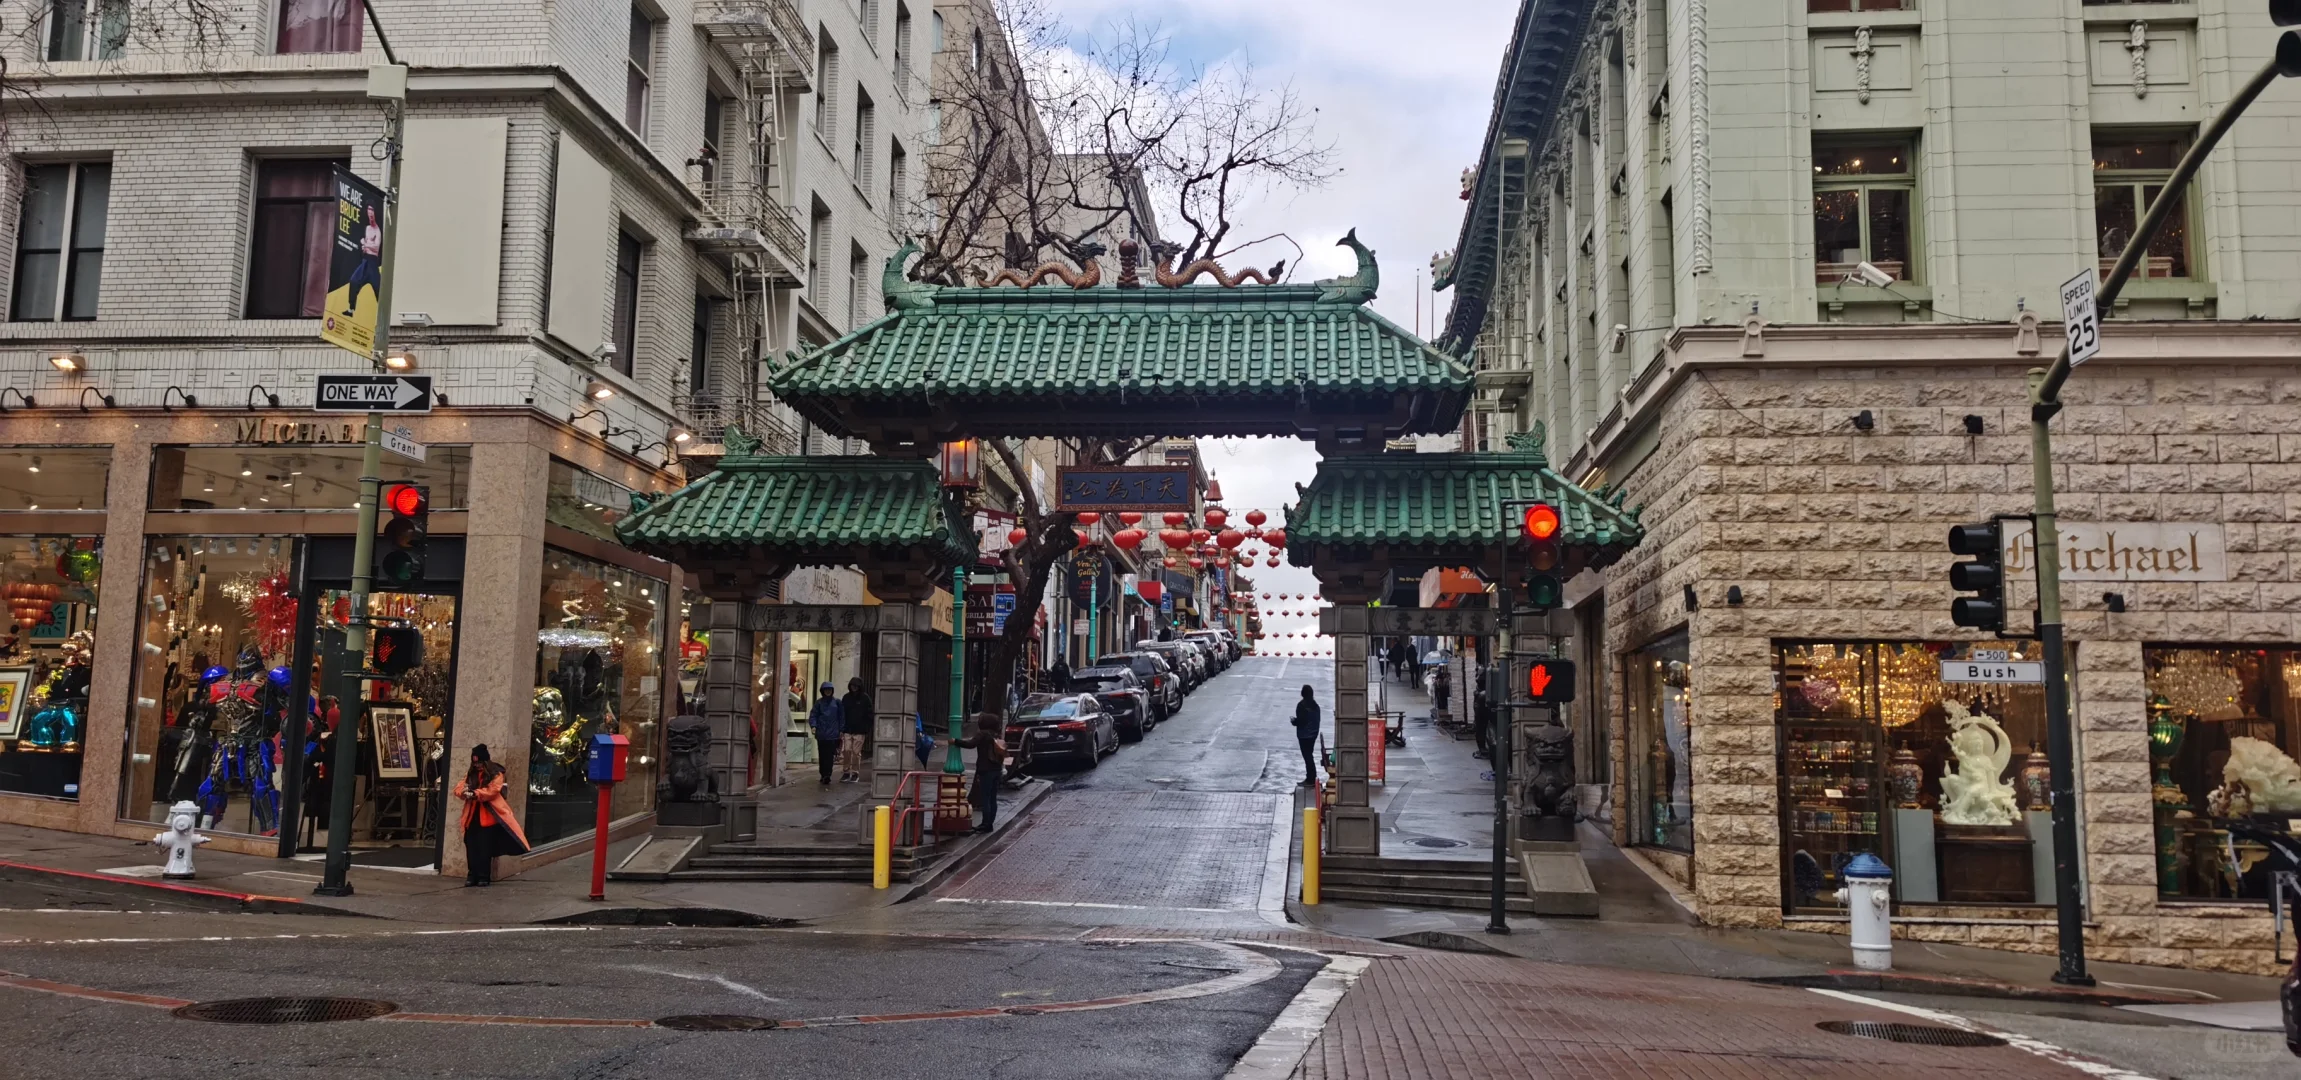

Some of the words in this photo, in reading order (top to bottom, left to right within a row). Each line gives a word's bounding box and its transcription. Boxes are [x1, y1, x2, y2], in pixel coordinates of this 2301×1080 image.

[340, 181, 350, 201] WE
[350, 188, 363, 208] ARE
[340, 198, 360, 224] BRUCE
[340, 215, 350, 235] LEE
[2064, 280, 2091, 305] SPEED
[2069, 298, 2090, 320] LIMIT
[2069, 315, 2095, 355] 25
[326, 385, 359, 400] ONE
[364, 385, 398, 400] WAY
[391, 437, 416, 456] Grant
[1986, 650, 2005, 660] 500
[1968, 665, 2017, 679] Bush
